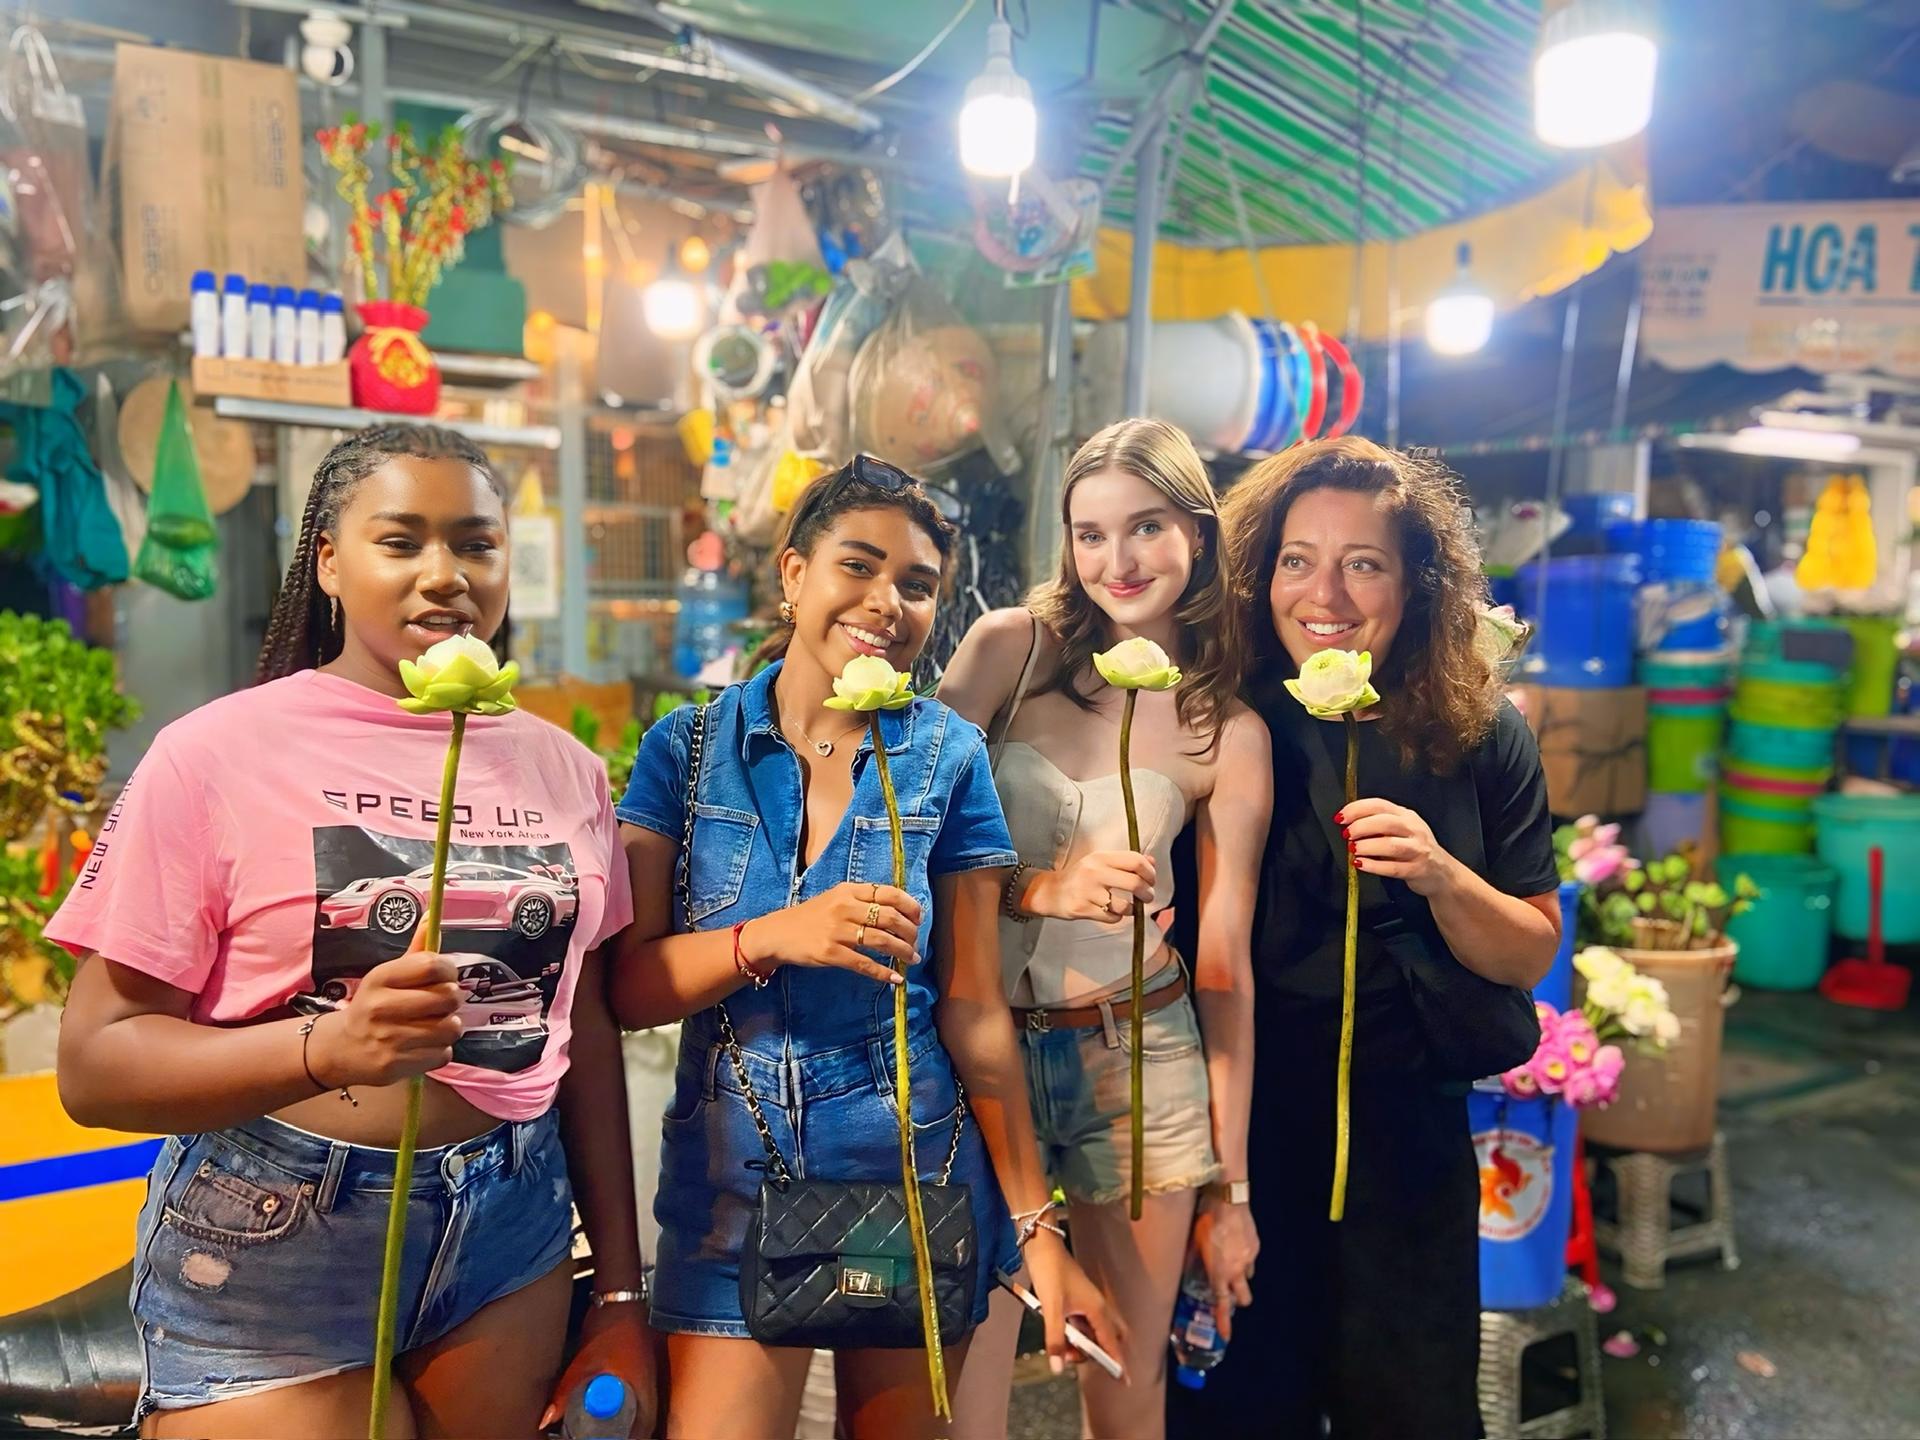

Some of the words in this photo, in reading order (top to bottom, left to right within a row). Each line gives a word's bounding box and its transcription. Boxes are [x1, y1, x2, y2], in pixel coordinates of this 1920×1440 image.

[1760, 221, 1878, 295] HOA
[459, 828, 484, 839] New
[488, 829, 514, 839] York
[496, 806, 544, 828] UP
[80, 841, 109, 890] NEW
